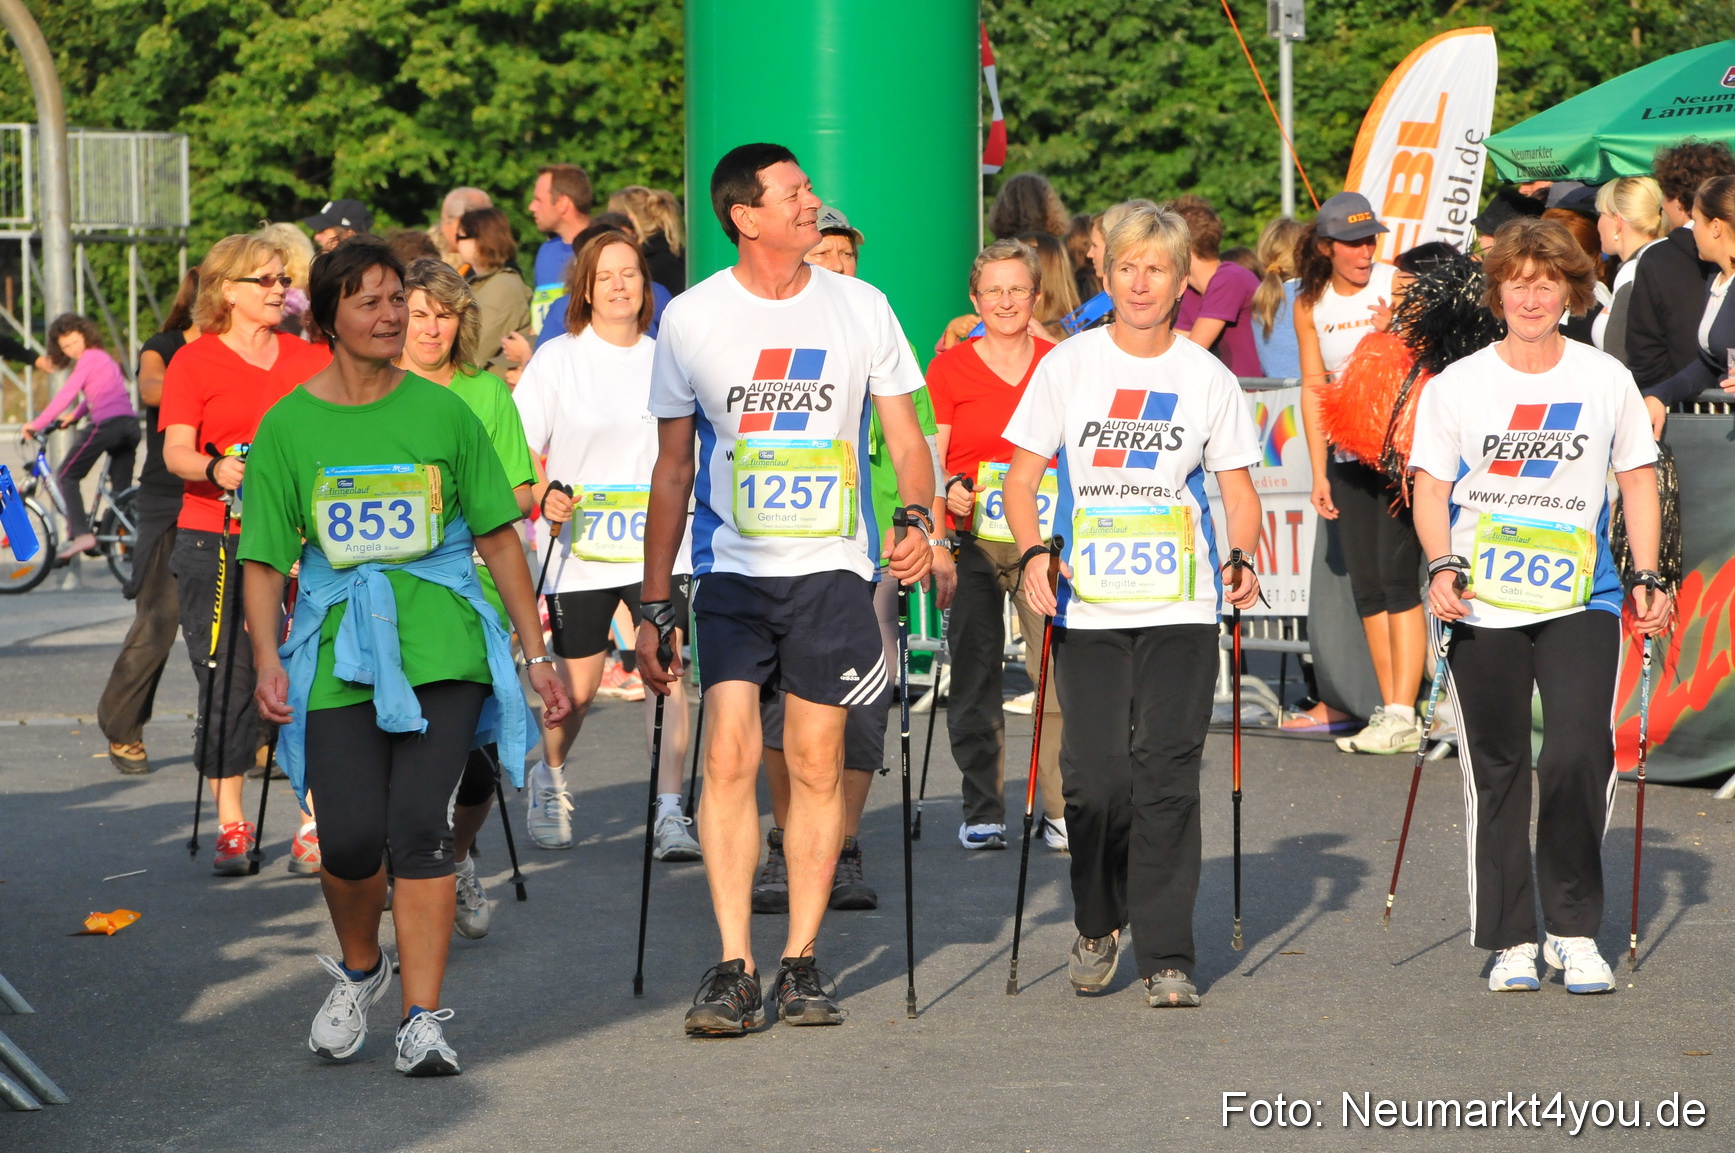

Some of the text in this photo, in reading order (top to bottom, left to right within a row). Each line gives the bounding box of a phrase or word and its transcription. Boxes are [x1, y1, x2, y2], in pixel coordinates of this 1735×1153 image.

[1641, 103, 1735, 120] Lamm
[1511, 146, 1553, 161] Neumarkter
[747, 382, 818, 393] AUTOHAUS
[726, 383, 836, 414] PERRAS
[1102, 420, 1170, 432] AUTOHAUS
[1078, 421, 1185, 451] PERRAS
[1501, 432, 1572, 442] AUTOHAUS
[1482, 434, 1589, 461] PERRAS
[750, 458, 789, 468] firmenlauf
[1254, 476, 1288, 488] edien
[329, 485, 370, 496] firmenlauf
[740, 474, 838, 509] 1257
[985, 490, 1051, 526] 62
[1469, 489, 1586, 512] www.perras.de
[327, 499, 415, 542] 853
[757, 512, 797, 522] Gerhard
[584, 511, 645, 541] 706
[1492, 531, 1531, 544] firmenlauf
[345, 543, 382, 554] Angela
[1081, 541, 1177, 575] 1258
[1480, 547, 1575, 592] 1262
[1101, 579, 1137, 590] Brigitte
[1500, 585, 1522, 596] Gabi
